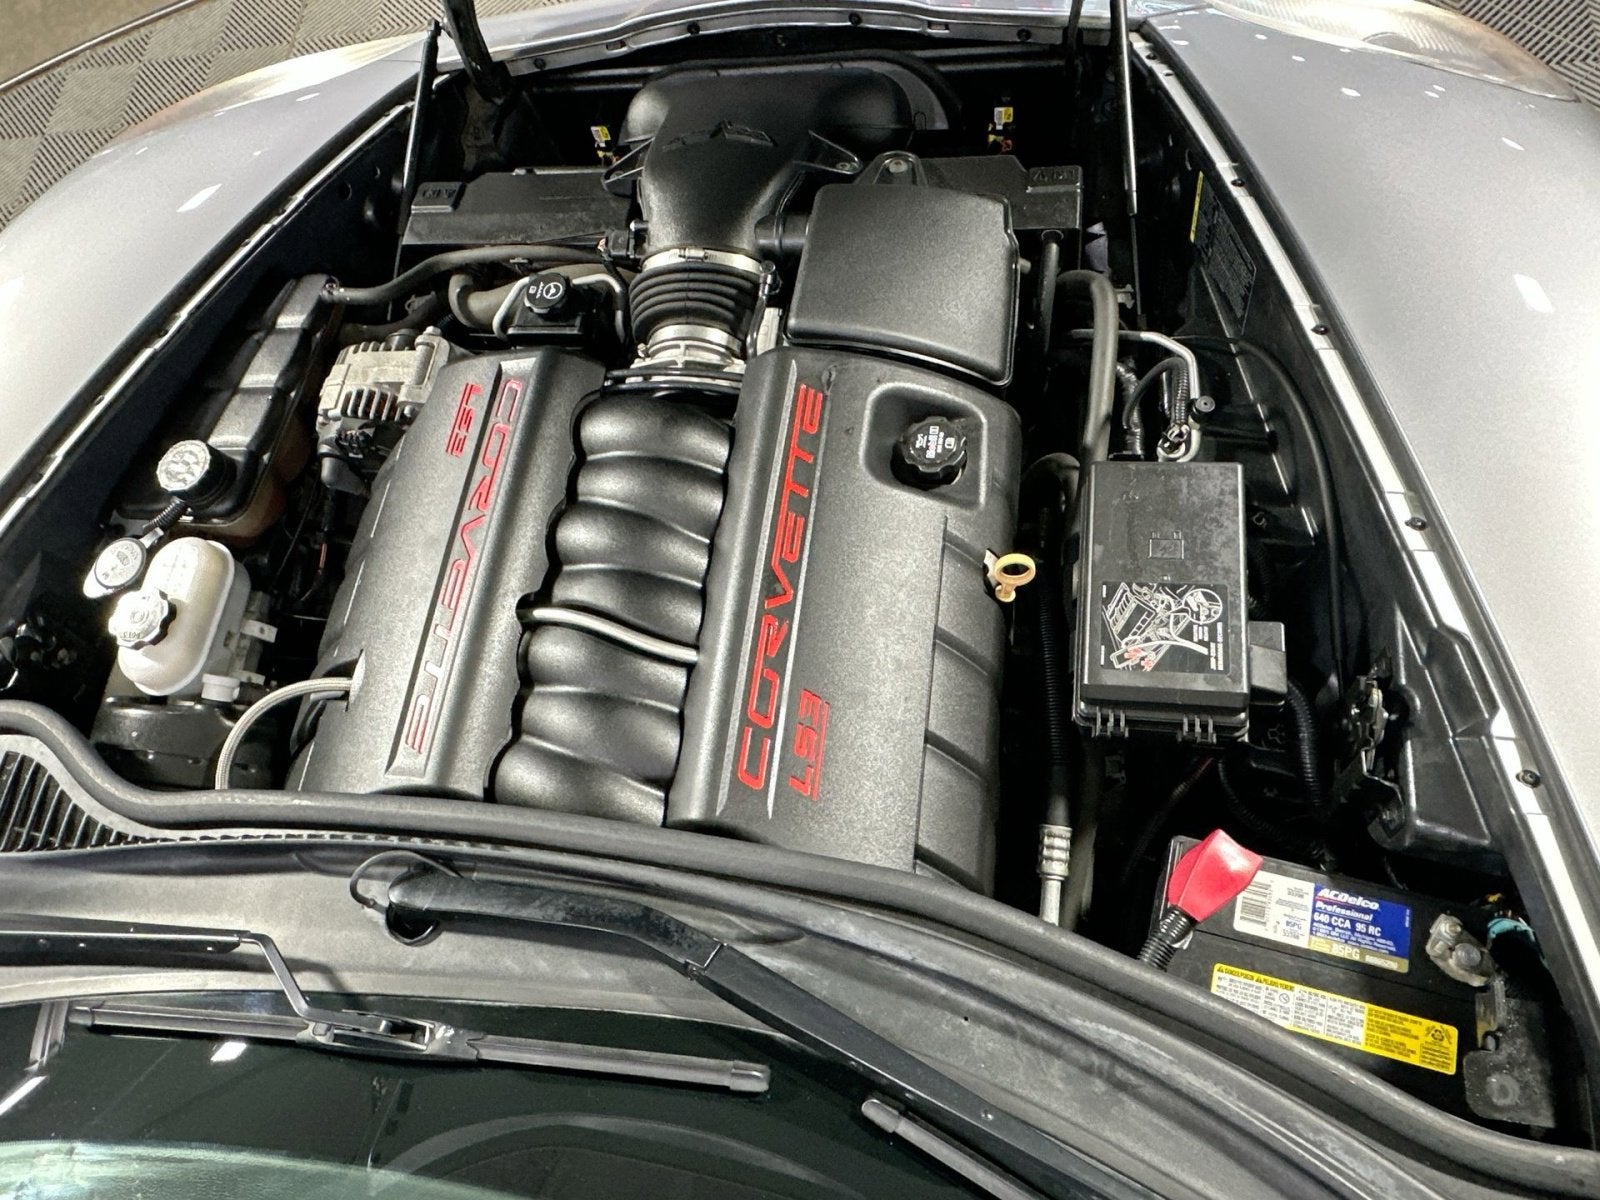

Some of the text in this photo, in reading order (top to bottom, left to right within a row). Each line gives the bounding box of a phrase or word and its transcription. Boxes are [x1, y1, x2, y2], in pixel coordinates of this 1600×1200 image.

[446, 382, 483, 457] LS3
[406, 379, 523, 754] CORVETTE
[738, 383, 823, 790] CORVETTE
[789, 688, 830, 801] LS3
[1313, 912, 1330, 924] 640
[1331, 914, 1352, 930] CCA
[1355, 922, 1367, 934] 95
[1368, 925, 1382, 937] RC
[1315, 901, 1374, 921] Professional
[1317, 888, 1380, 909] ACDelco
